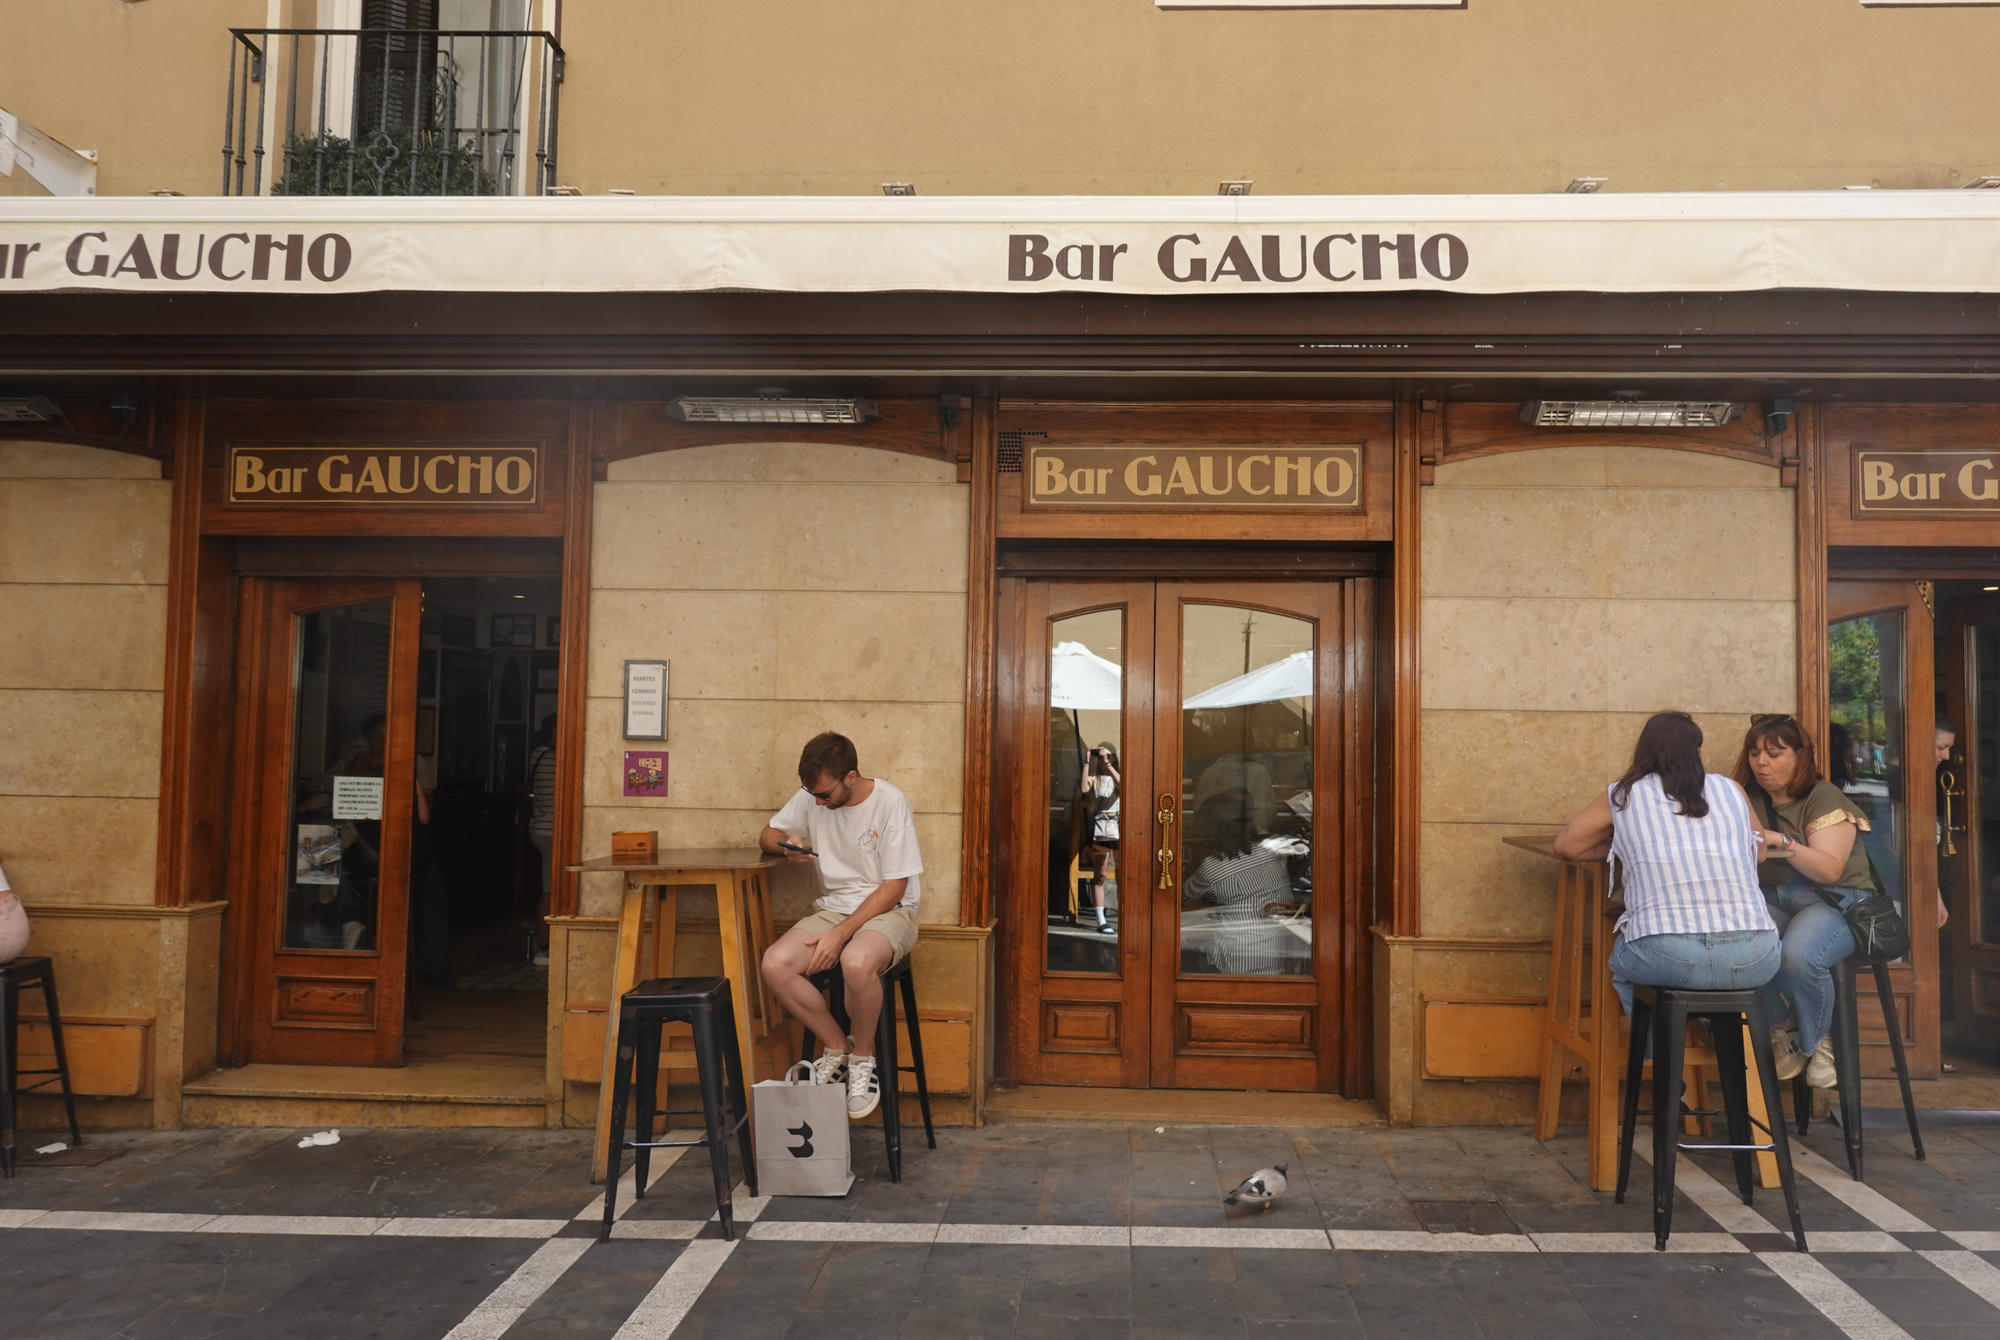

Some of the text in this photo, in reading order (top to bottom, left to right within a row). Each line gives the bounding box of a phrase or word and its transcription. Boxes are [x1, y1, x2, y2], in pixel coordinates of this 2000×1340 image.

[65, 231, 352, 282] GAUCHO
[1008, 232, 1469, 283] Bar GAUCHO
[233, 454, 532, 495] Bar GAUCHO
[1034, 455, 1354, 496] Bar GAUCHO
[1863, 461, 1946, 500] Bar
